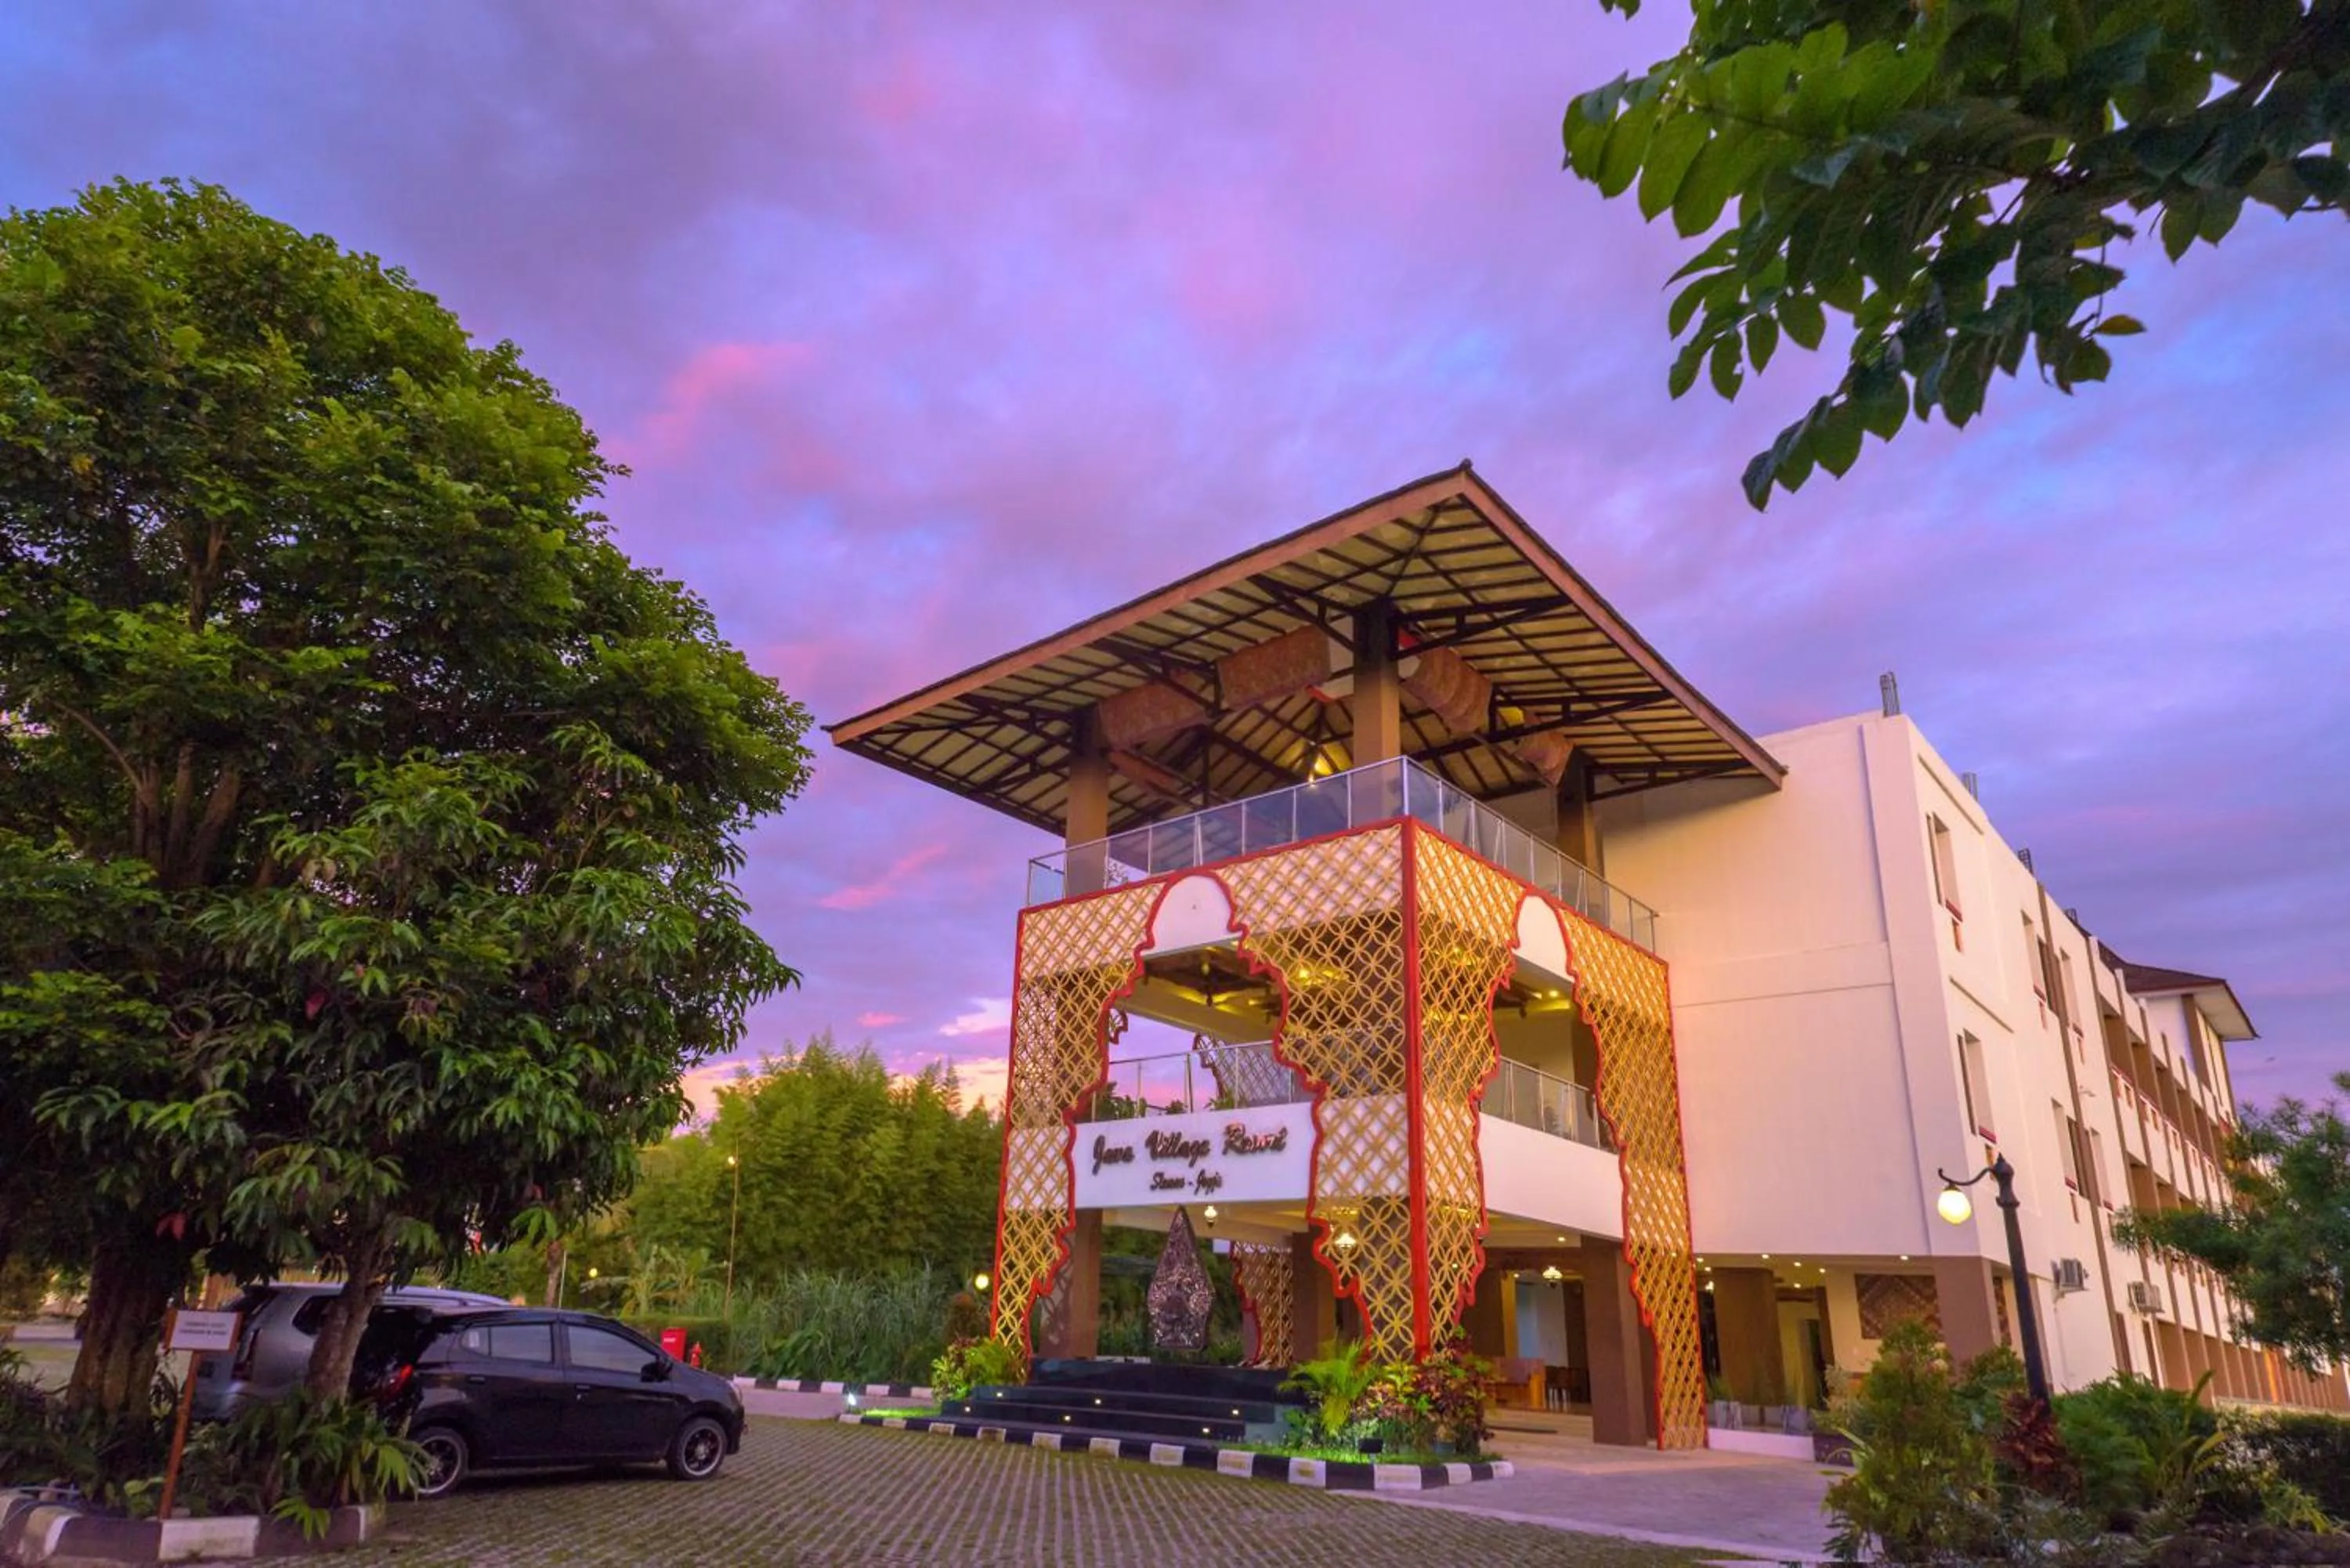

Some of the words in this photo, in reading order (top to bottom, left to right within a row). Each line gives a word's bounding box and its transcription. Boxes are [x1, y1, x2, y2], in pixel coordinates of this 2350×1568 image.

[1092, 1135, 1135, 1176] Java
[1145, 1129, 1210, 1168] Village
[1222, 1122, 1288, 1155] Resort
